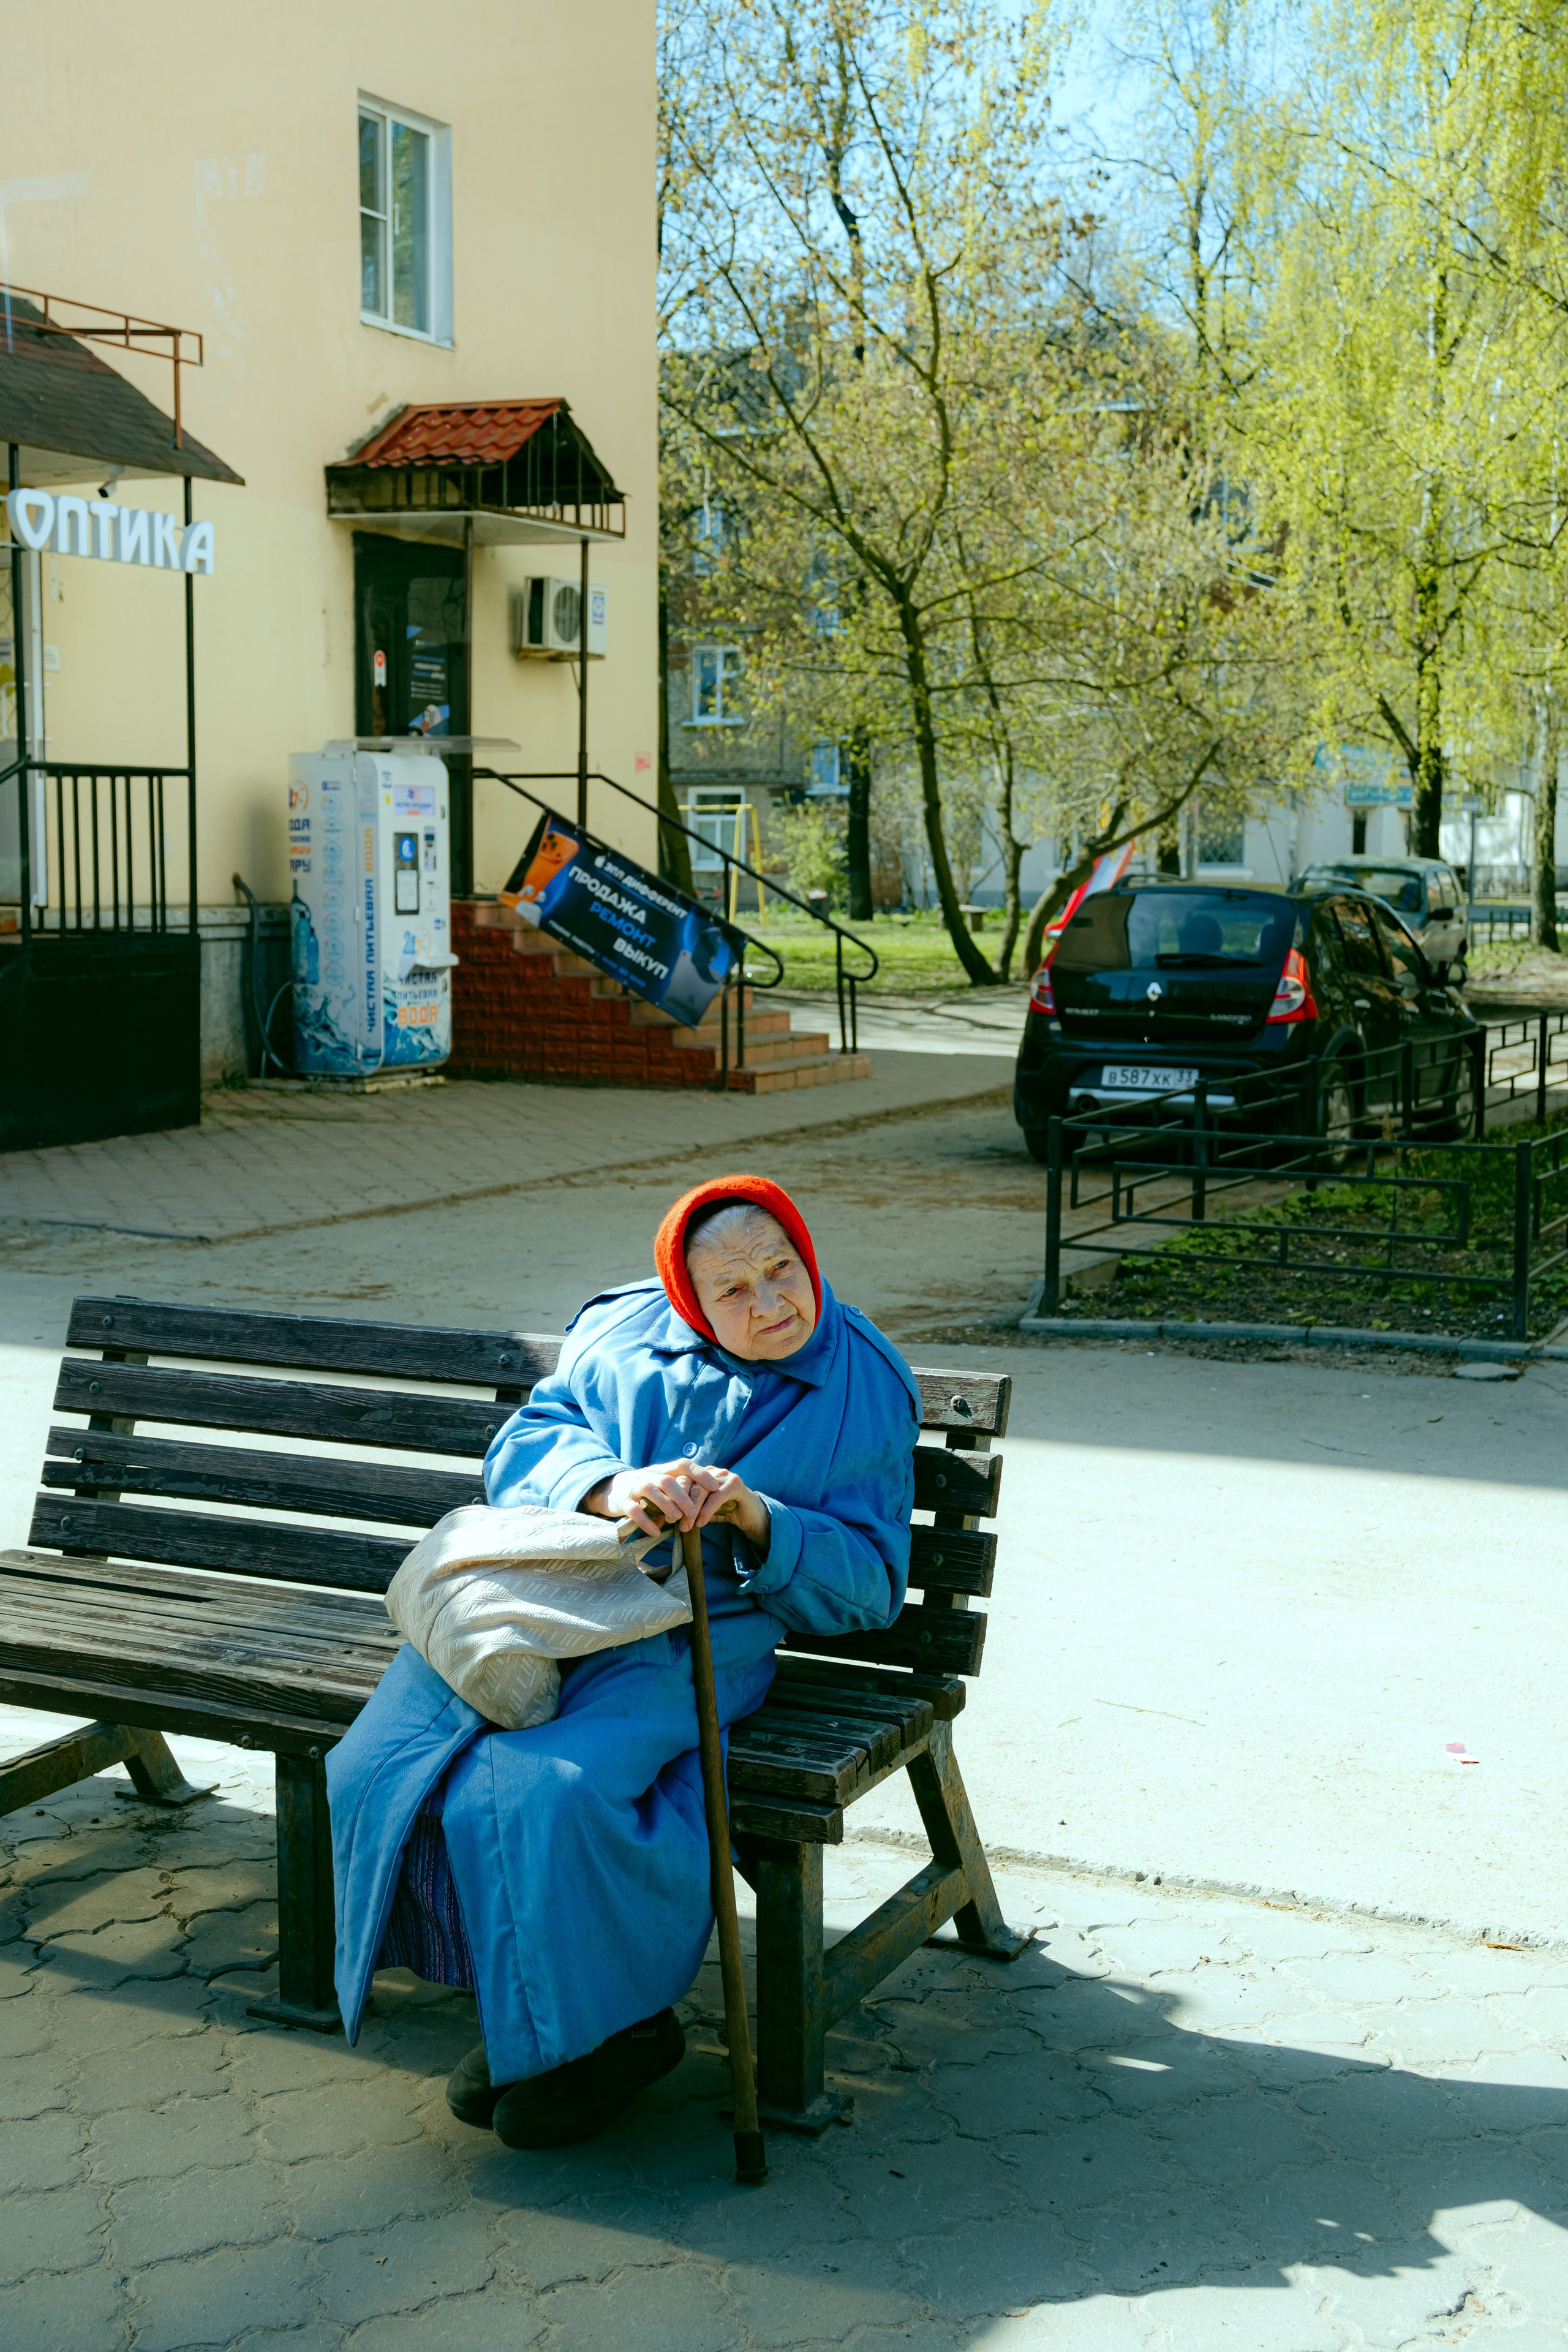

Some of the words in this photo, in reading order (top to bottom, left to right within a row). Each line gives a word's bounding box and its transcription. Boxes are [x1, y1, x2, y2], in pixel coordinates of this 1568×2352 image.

[7, 488, 214, 575] ОПТИКА
[290, 818, 311, 831] ОДА
[290, 859, 311, 872] АРУ
[568, 865, 647, 924] ПРОДАЖА
[622, 875, 688, 919] ДИФФЕРЕНТ
[365, 879, 374, 963] ПИТЬЕВАЯ
[589, 900, 657, 948] РЕМОНТ
[612, 937, 669, 979] ВЫКУП
[366, 971, 375, 1032] ЧИСТАЯ
[398, 1005, 438, 1026] ВОДА
